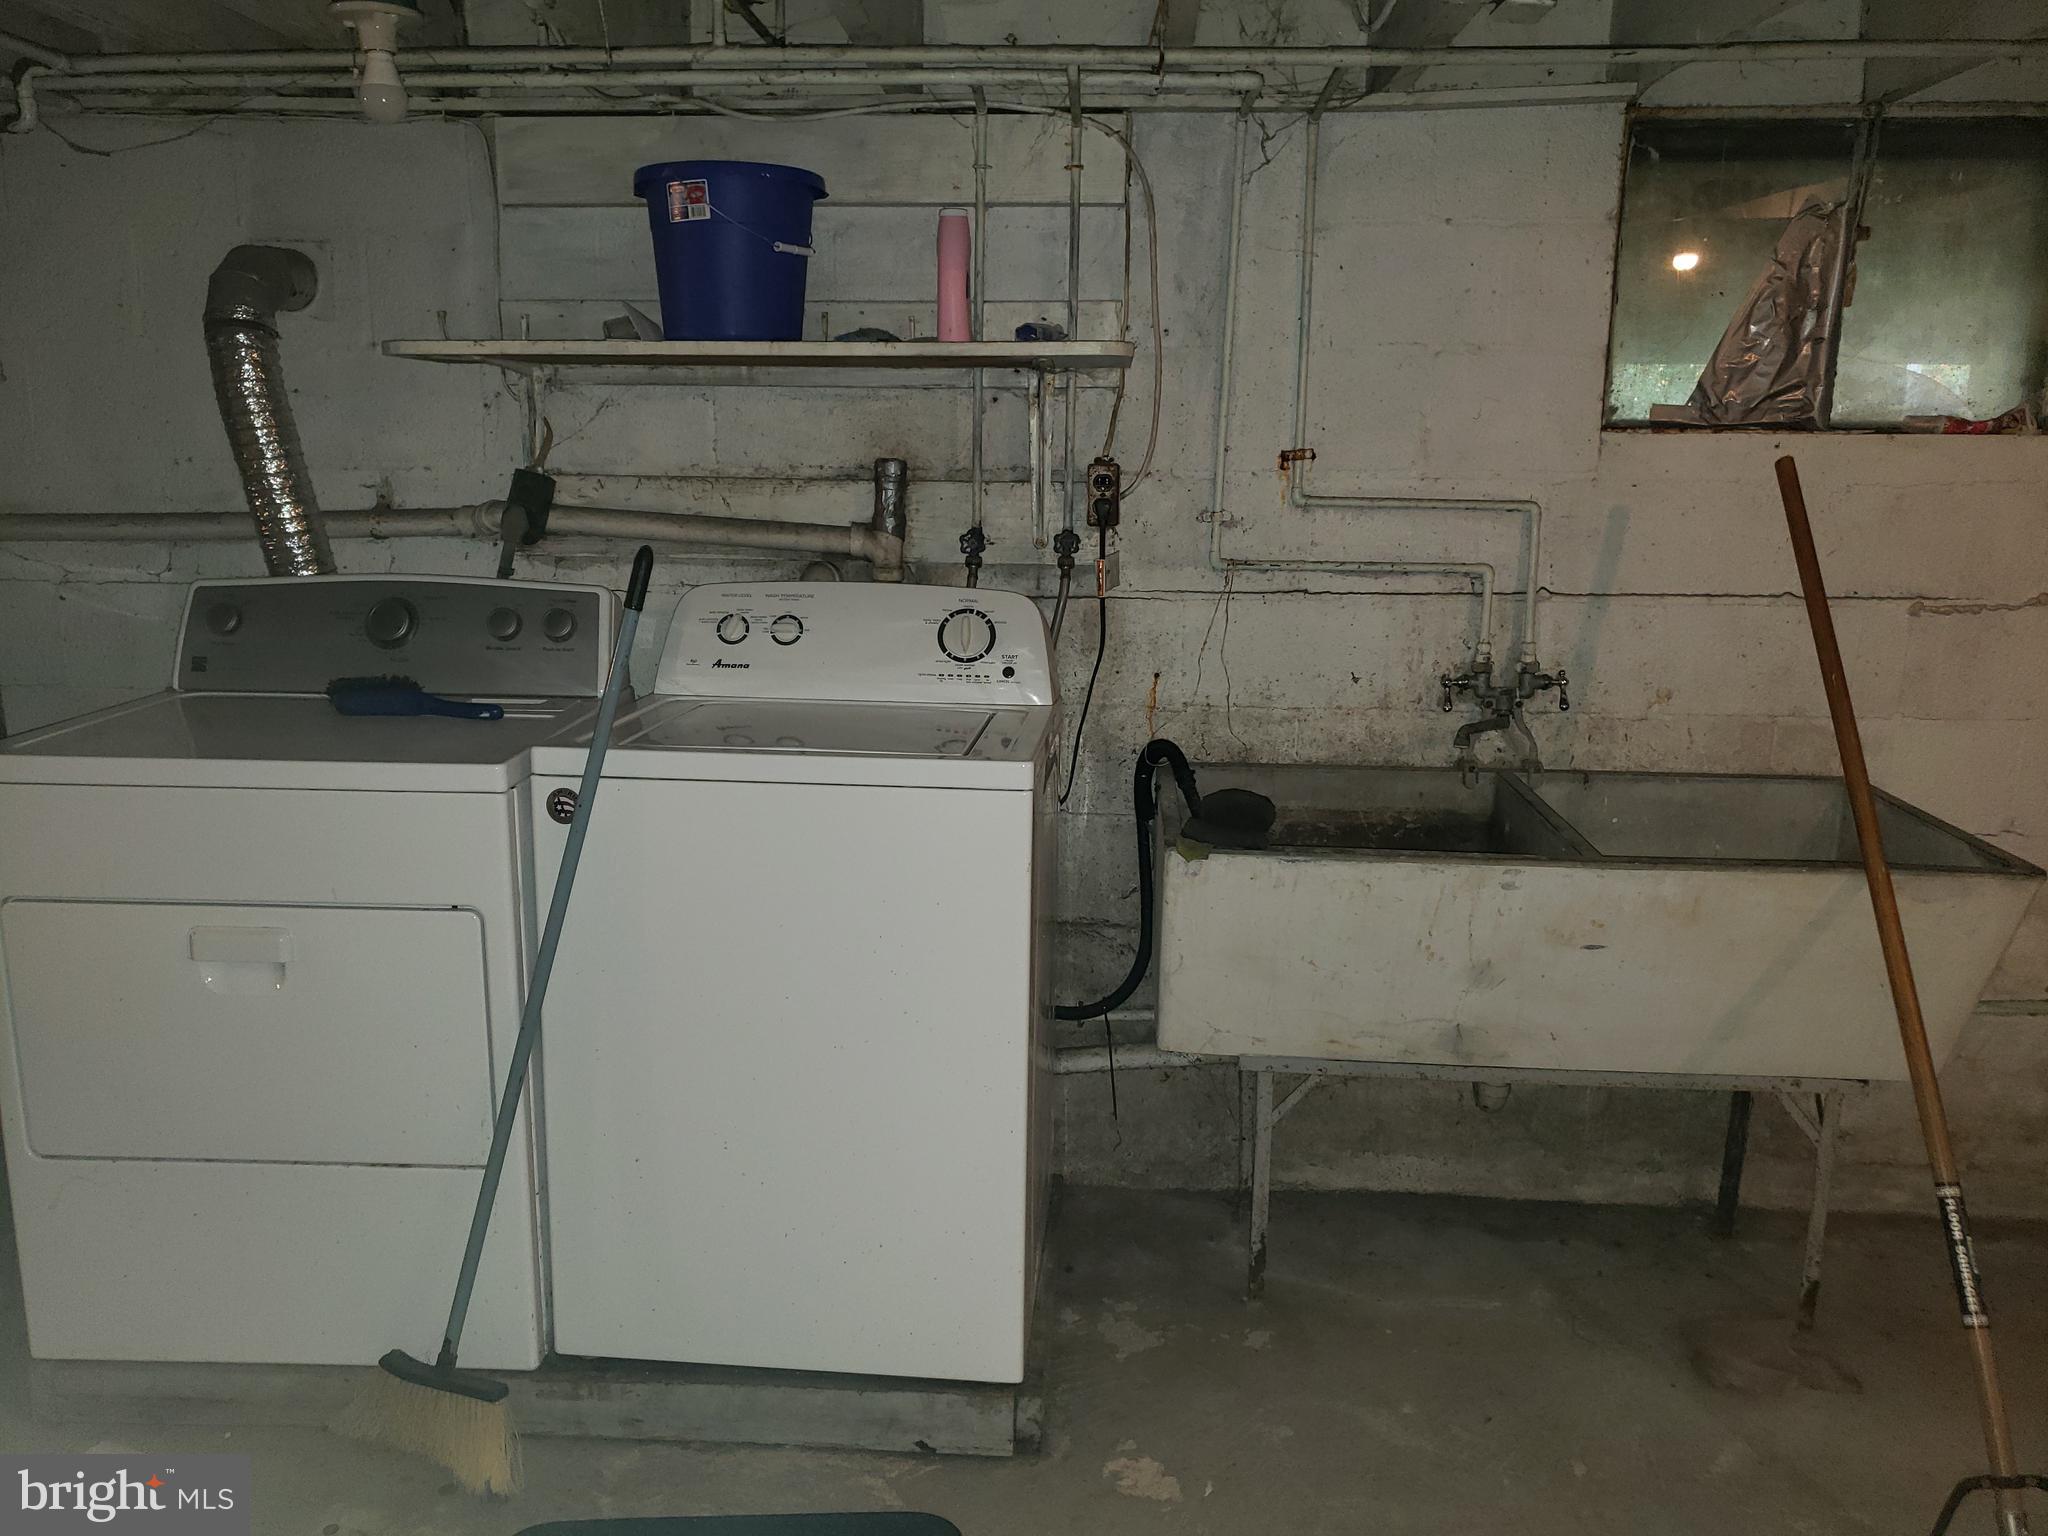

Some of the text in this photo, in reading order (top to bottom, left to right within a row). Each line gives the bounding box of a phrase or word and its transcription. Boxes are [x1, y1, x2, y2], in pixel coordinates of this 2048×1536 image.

[711, 658, 750, 669] Amana
[1944, 1198, 1980, 1313] FLOOR SQUEEGEE
